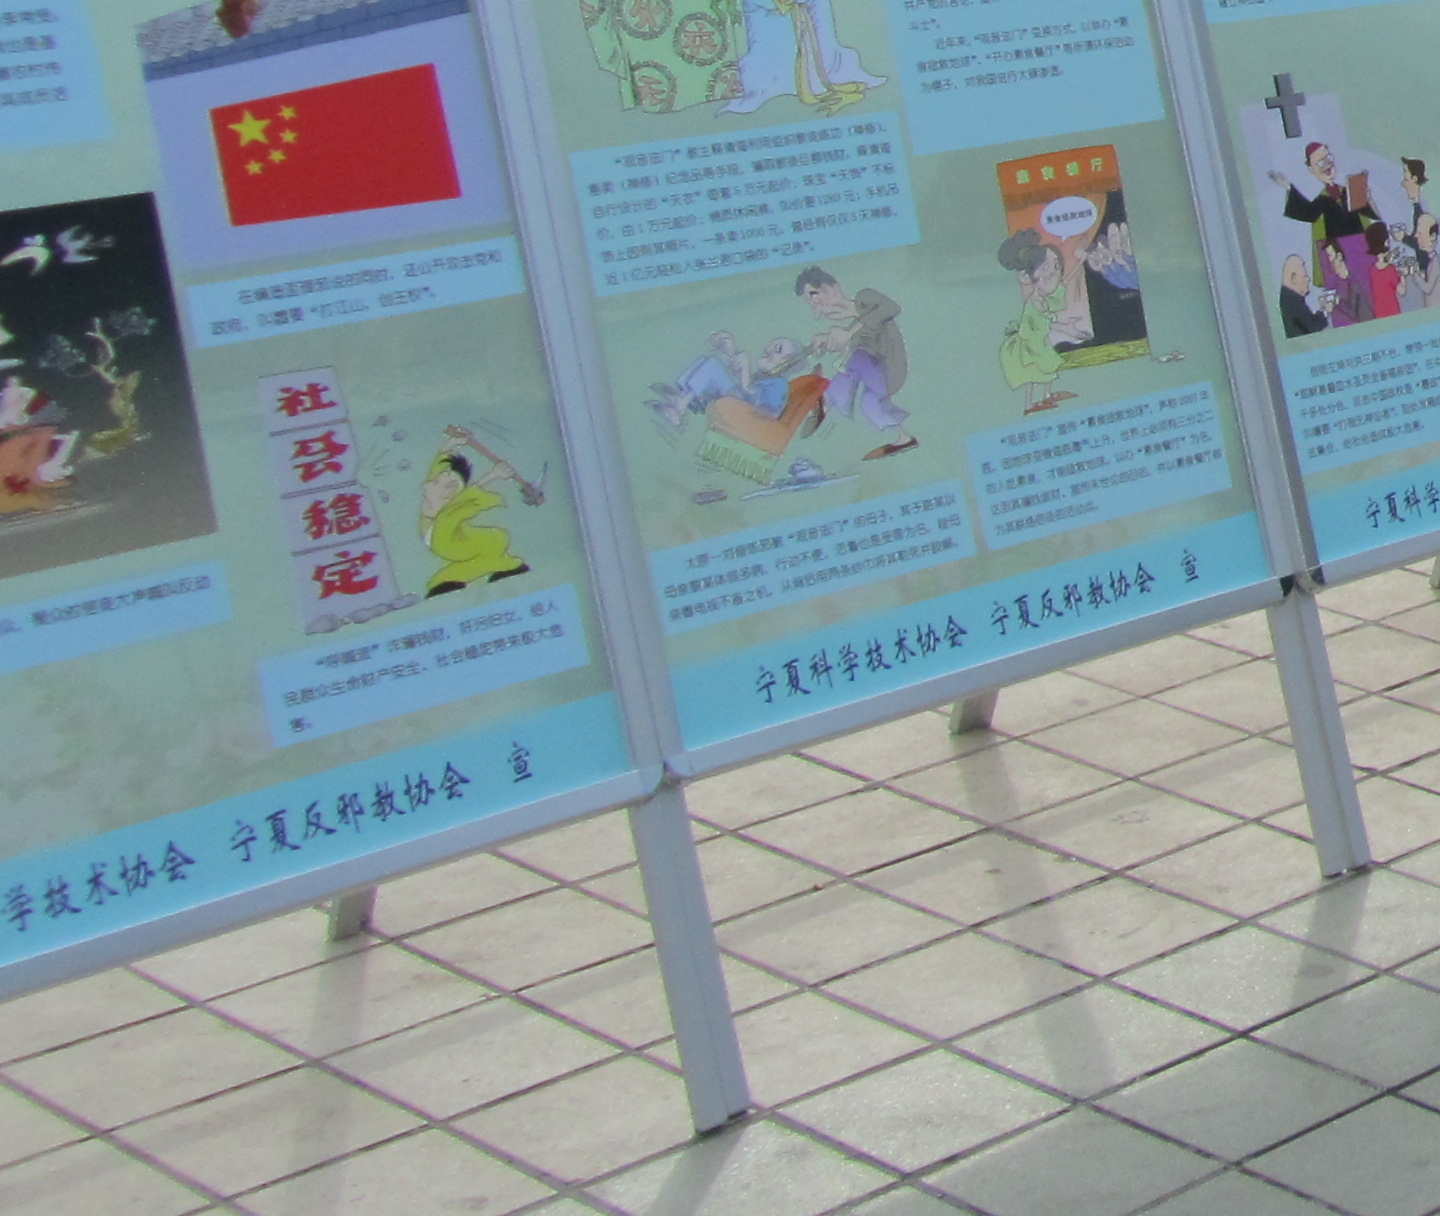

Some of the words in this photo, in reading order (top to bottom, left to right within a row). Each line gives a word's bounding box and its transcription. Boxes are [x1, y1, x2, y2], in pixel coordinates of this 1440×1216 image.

[275, 381, 380, 600] 社会稳定
[754, 614, 971, 706] 宁夏科学技术协会
[989, 561, 1158, 637] 宁夏反邪教协会
[1180, 548, 1201, 583] 宣
[0, 840, 197, 933] 学技术协会
[228, 759, 473, 864] 宁夏反邪教协会
[507, 742, 535, 784] 宣
